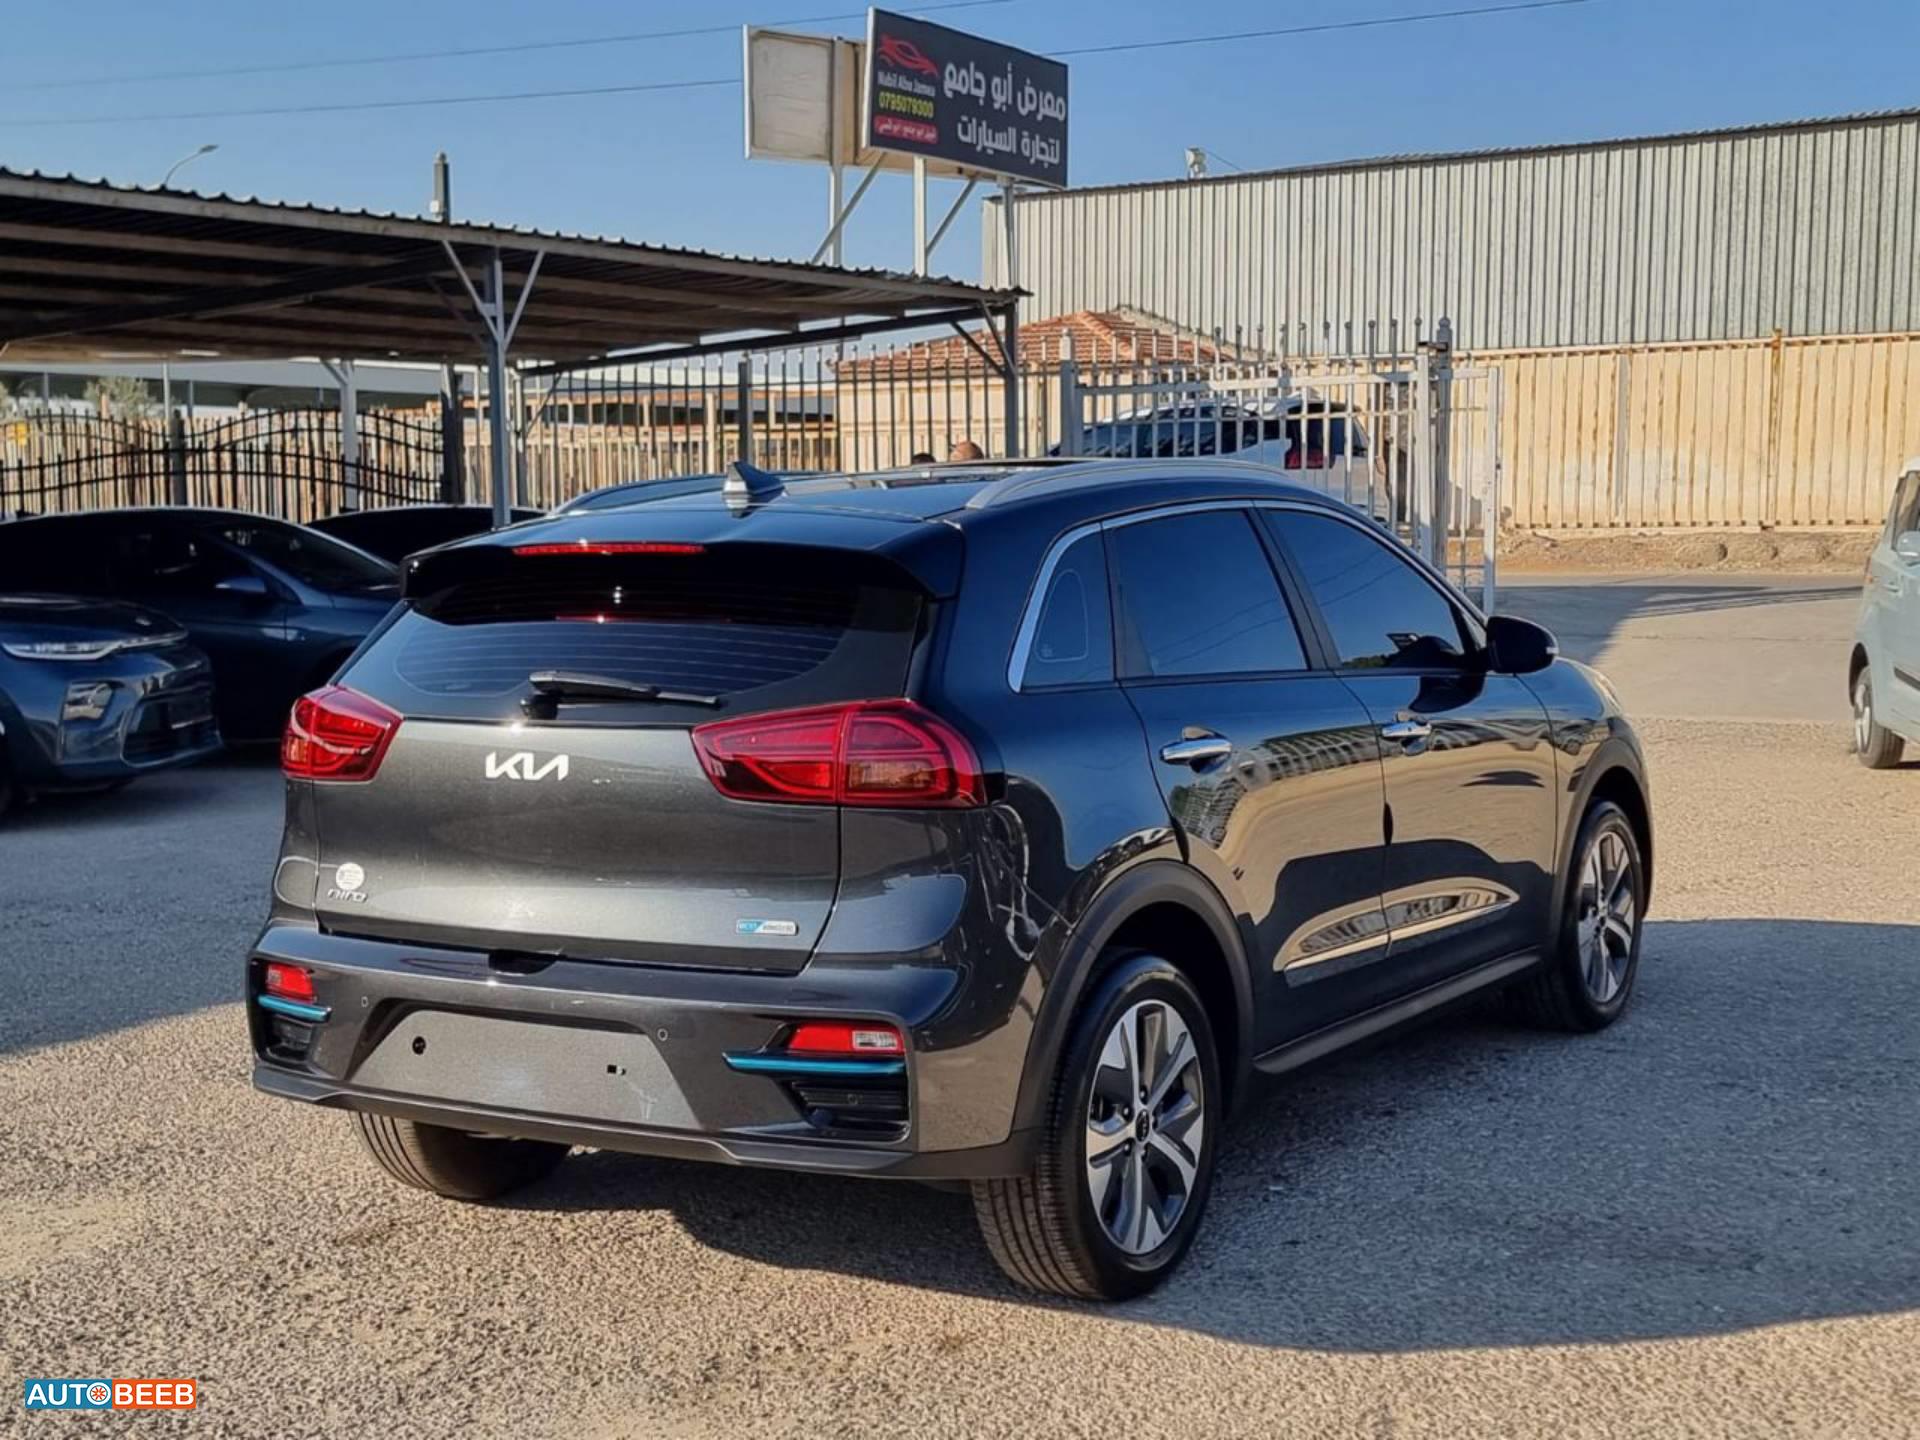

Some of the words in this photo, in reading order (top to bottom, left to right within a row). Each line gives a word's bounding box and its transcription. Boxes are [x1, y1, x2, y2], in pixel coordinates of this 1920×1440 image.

[944, 61, 986, 106] جامع
[991, 63, 1013, 111] أبو
[1017, 78, 1066, 121] معرض
[957, 116, 1017, 154] السيارات
[1021, 131, 1061, 168] لتجارة
[485, 751, 569, 781] KIA
